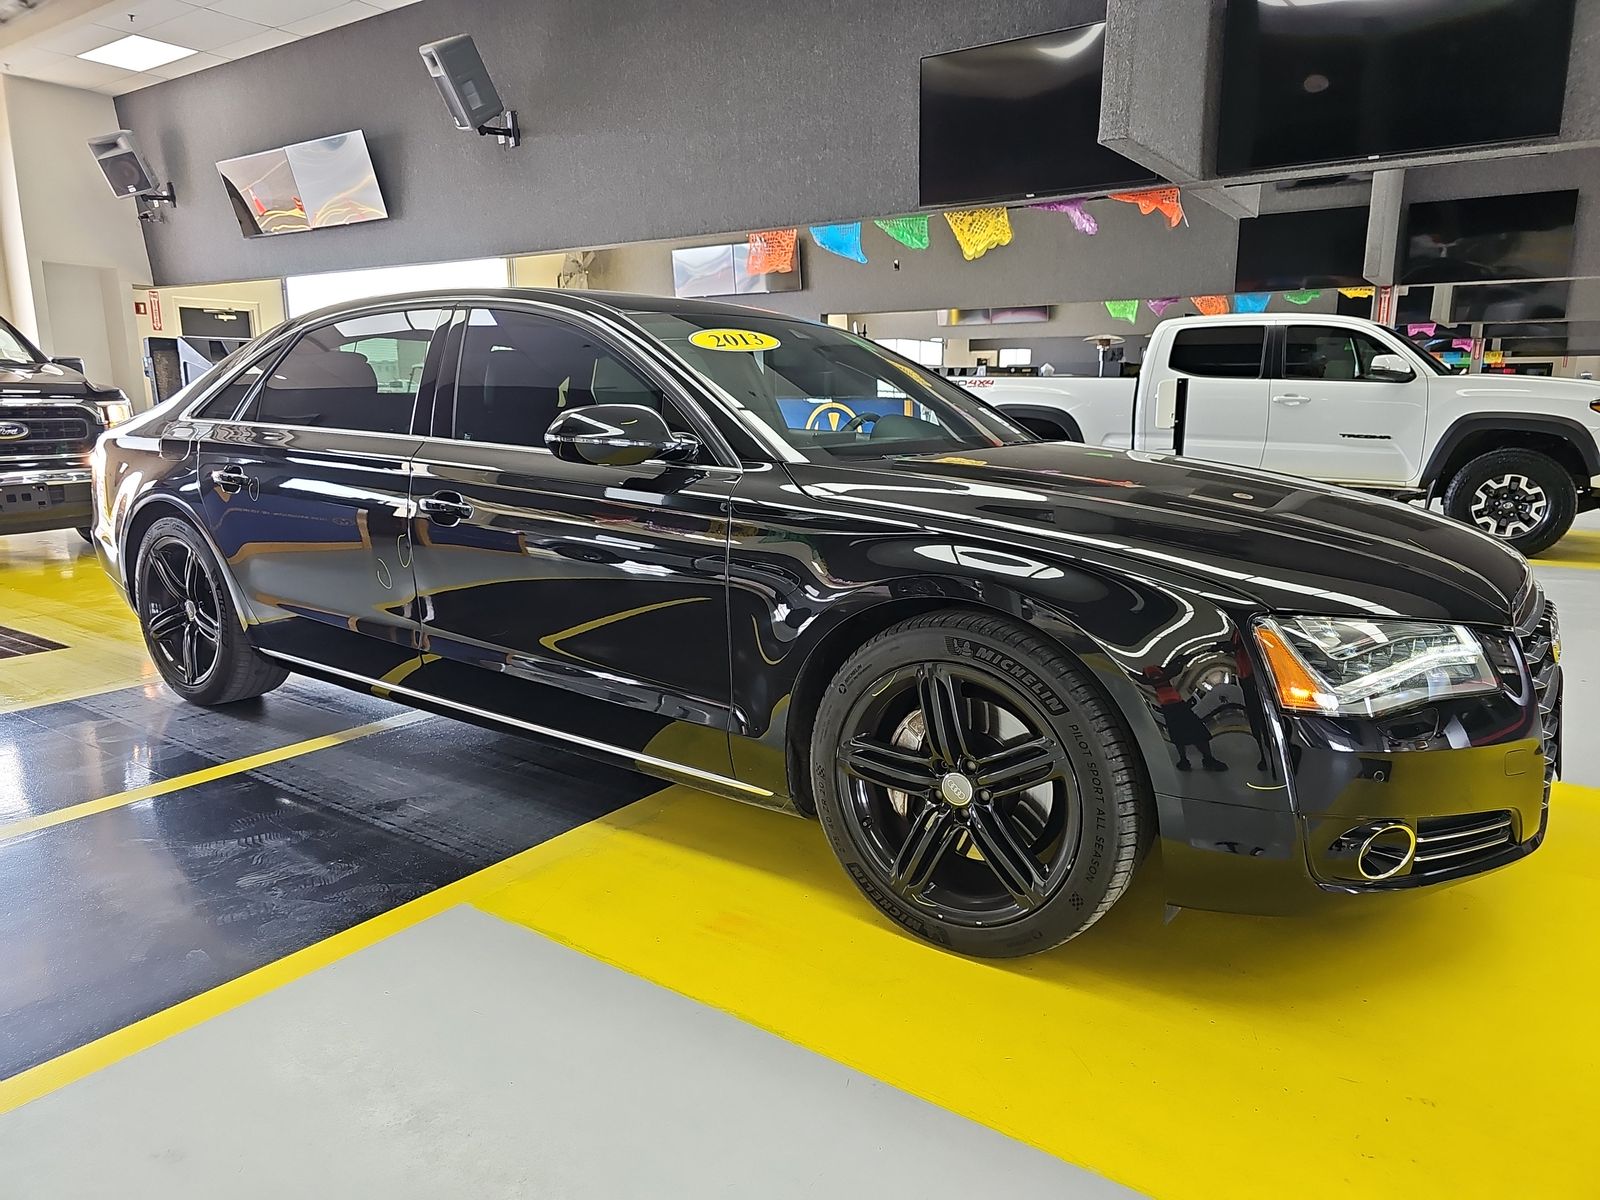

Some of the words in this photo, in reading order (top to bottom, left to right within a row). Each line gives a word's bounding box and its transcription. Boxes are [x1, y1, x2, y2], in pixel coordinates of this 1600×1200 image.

[708, 333, 764, 347] 2013
[975, 647, 1064, 713] MICHELIN
[1069, 723, 1093, 757] PILOT
[1086, 761, 1105, 803] SPORT
[1095, 807, 1106, 831] ALL
[1085, 834, 1106, 884] SEASON
[850, 863, 923, 932] MICHELIN
